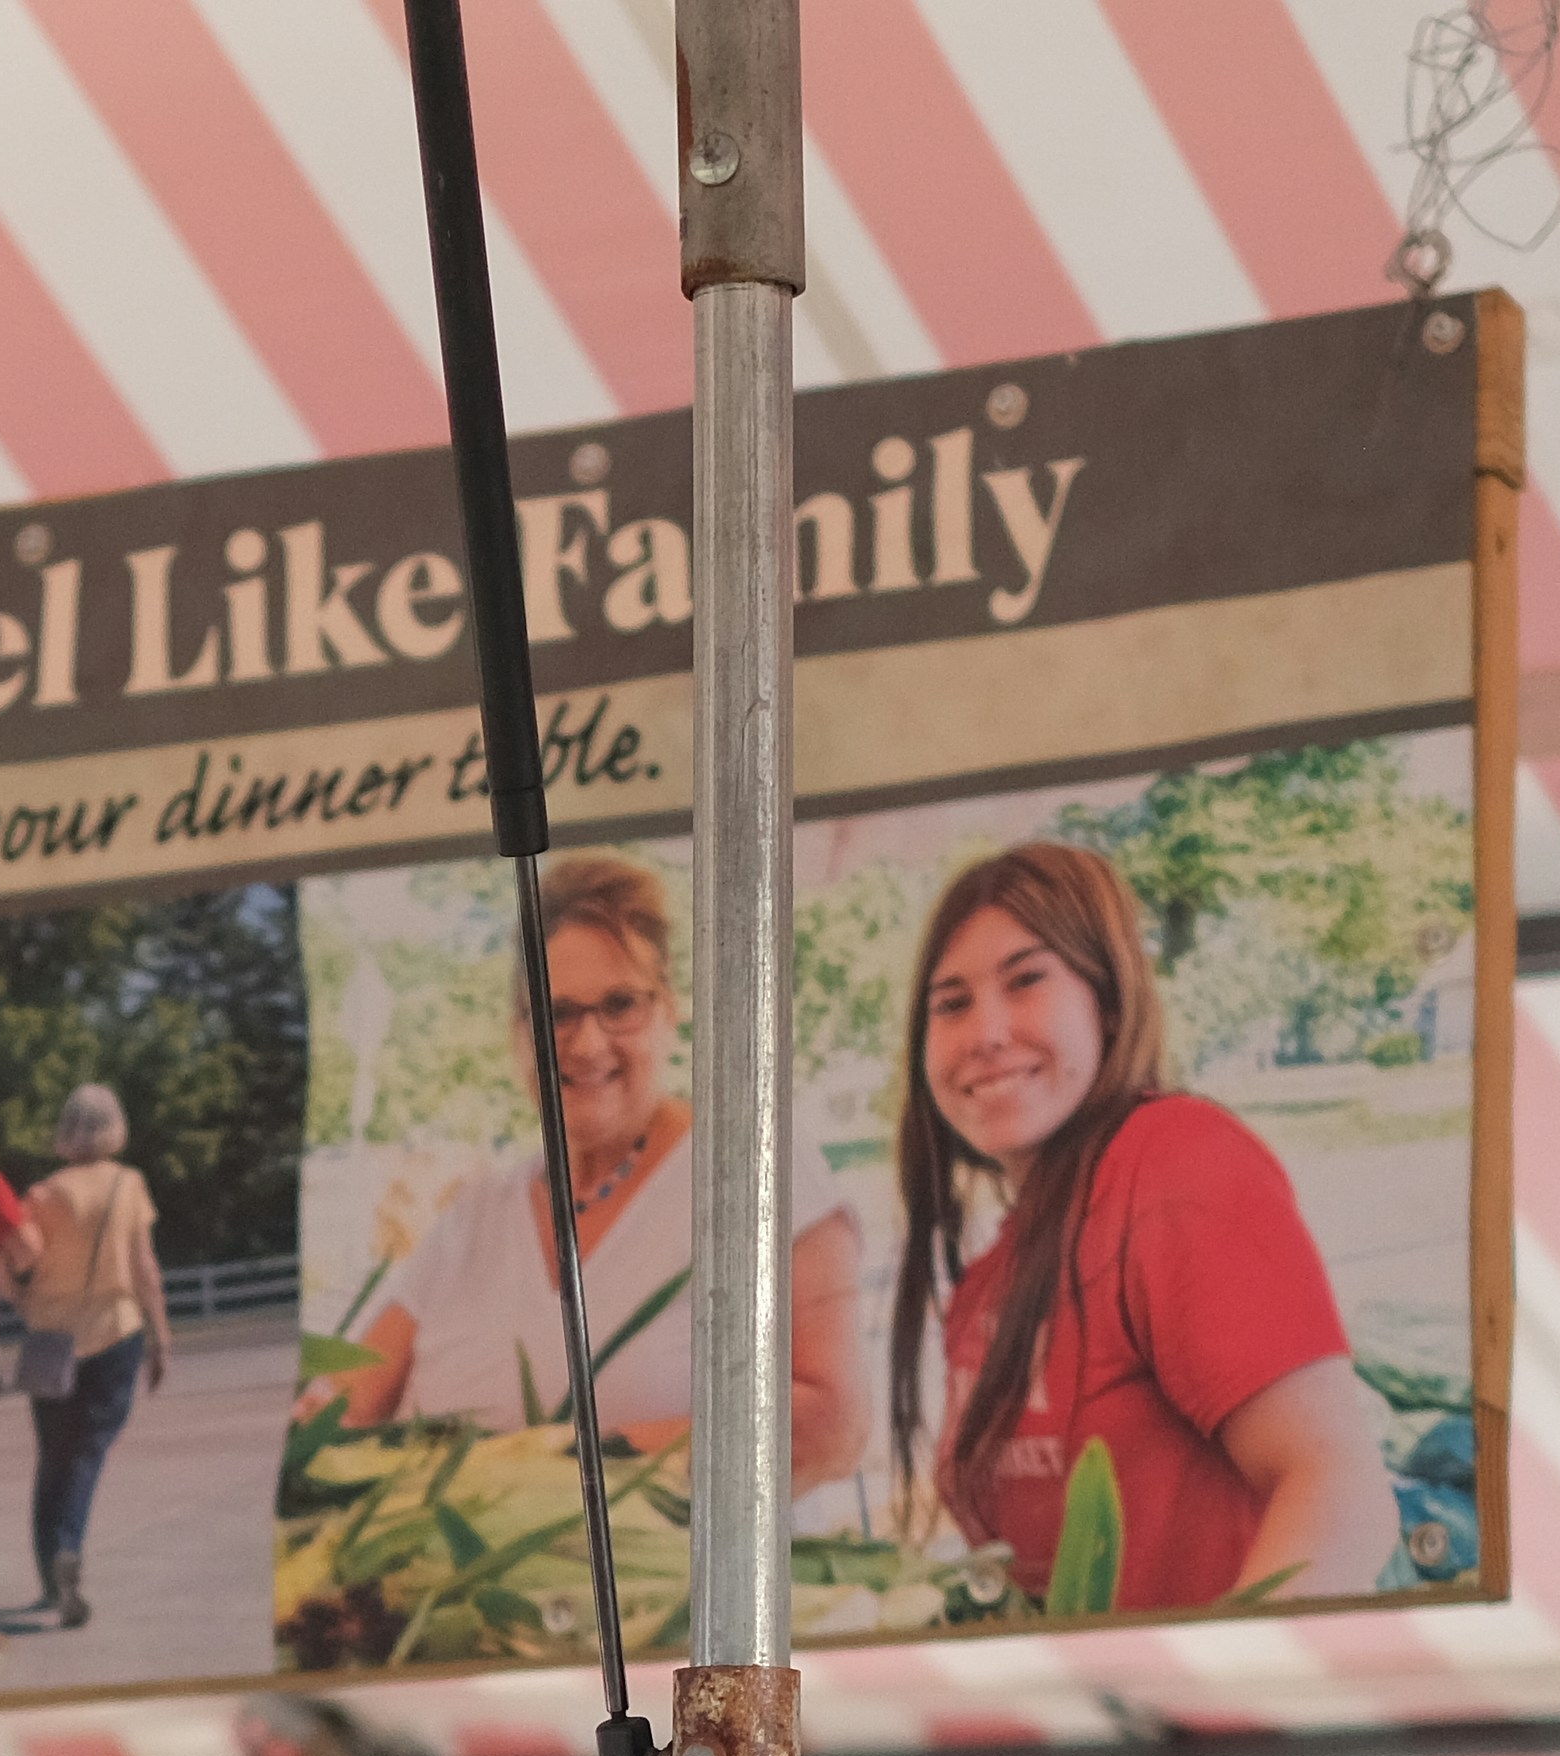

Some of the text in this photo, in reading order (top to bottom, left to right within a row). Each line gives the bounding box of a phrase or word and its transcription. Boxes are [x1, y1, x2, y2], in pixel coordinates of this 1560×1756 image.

[123, 519, 464, 698] Like
[156, 742, 431, 842] dinner
[448, 694, 663, 804] tble.
